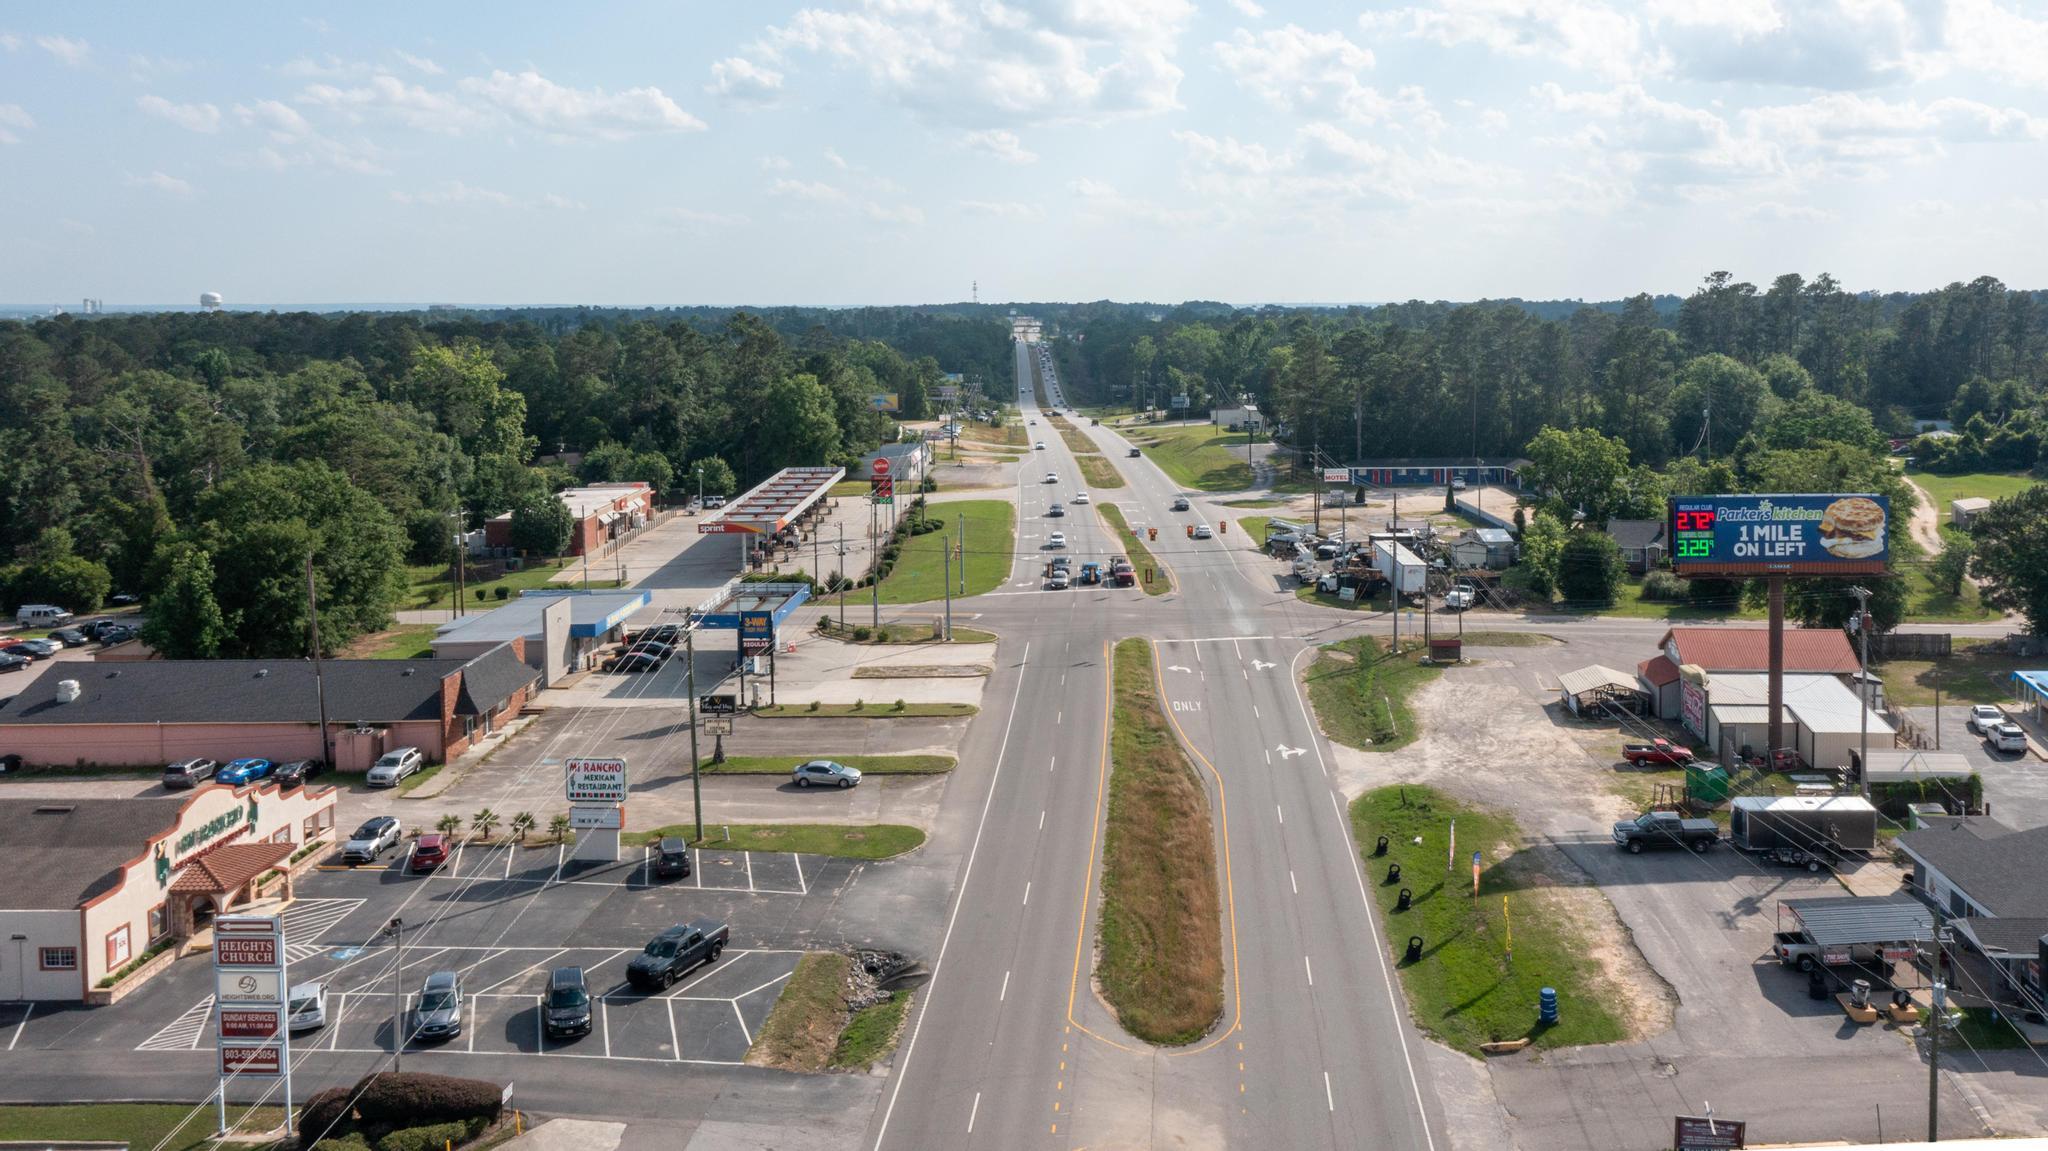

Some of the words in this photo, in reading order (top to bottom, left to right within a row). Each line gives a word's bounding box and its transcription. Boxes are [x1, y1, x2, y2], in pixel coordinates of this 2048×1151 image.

[1772, 506, 1823, 520] kitchen
[700, 524, 725, 534] sprint
[1740, 525, 1749, 541] 1
[1753, 525, 1802, 541] MILE
[1733, 542, 1759, 556] ON
[1764, 542, 1806, 556] LEFT
[745, 617, 767, 626] 3-WAY
[1173, 700, 1202, 711] ONLY
[583, 762, 622, 773] RANCHO
[220, 941, 273, 951] HEIGHTS
[221, 952, 273, 962] CHURCH
[223, 1013, 247, 1022] SUNDAY
[247, 1013, 276, 1022] SERVICES
[224, 1049, 277, 1059] 803-593054
